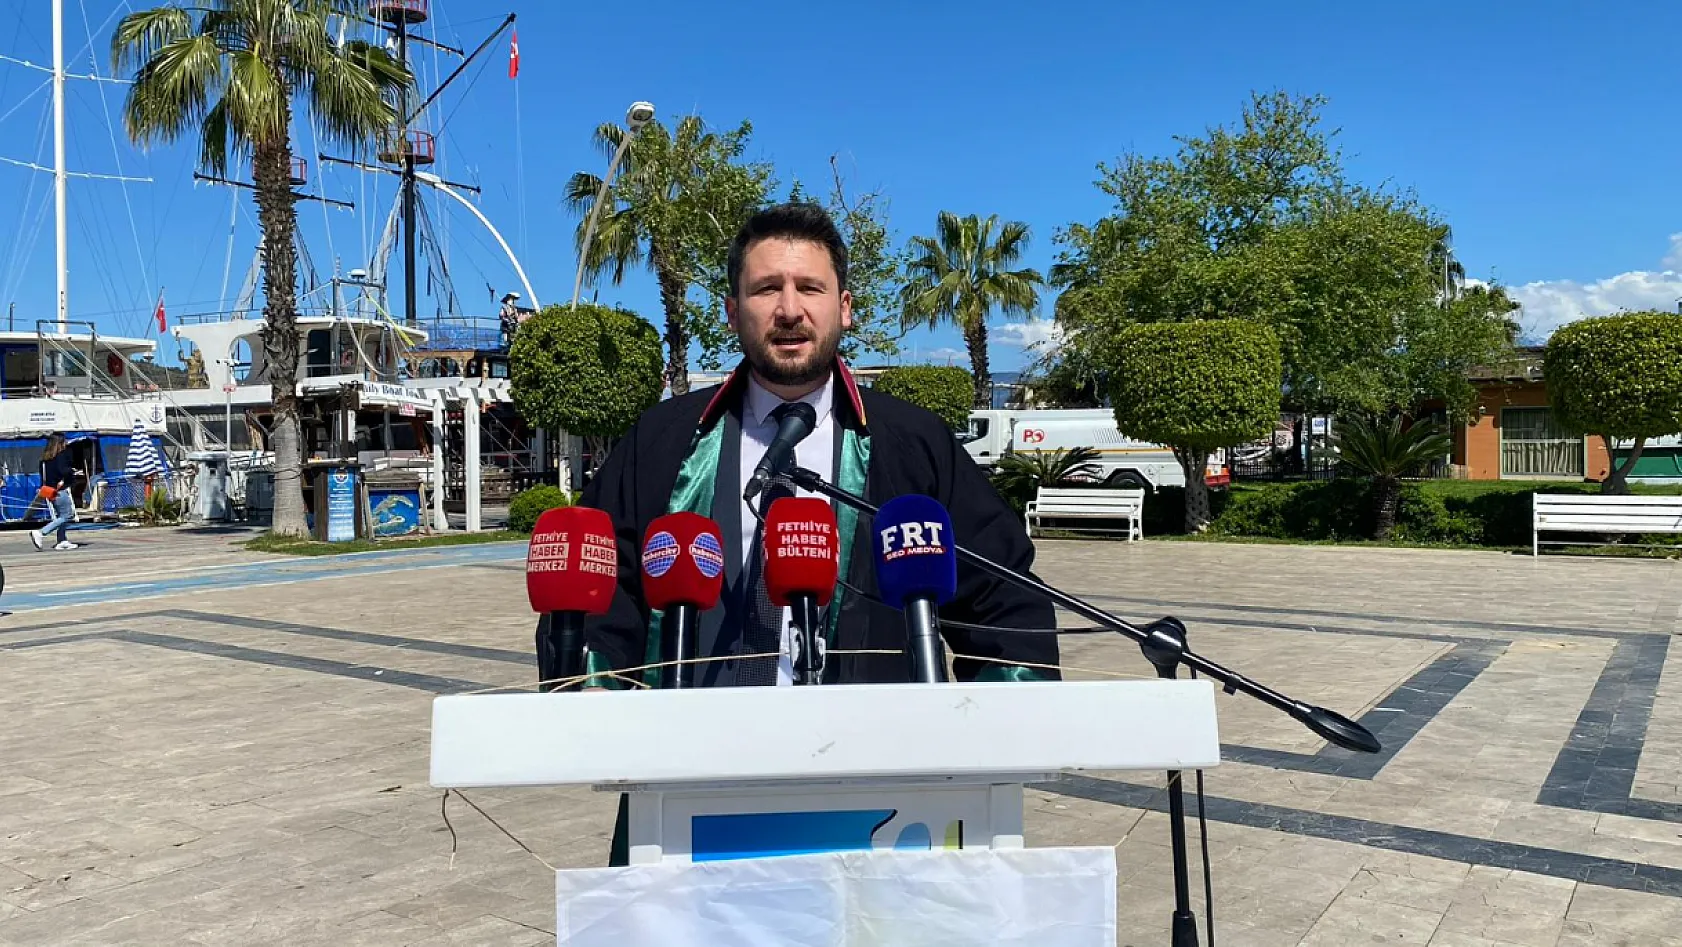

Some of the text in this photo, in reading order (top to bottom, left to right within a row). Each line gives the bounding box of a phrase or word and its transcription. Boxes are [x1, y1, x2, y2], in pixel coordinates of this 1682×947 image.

[363, 383, 379, 394] aily
[777, 520, 831, 534] FETHİYE
[533, 530, 569, 543] FETHİYE
[781, 534, 827, 546] HABER
[881, 521, 943, 554] FRT
[531, 545, 565, 557] HABER
[777, 545, 831, 559] BÜLTENİ
[907, 547, 943, 556] MEDYA
[528, 558, 567, 572] MERKEZİ
[579, 561, 616, 577] MERKEZ
